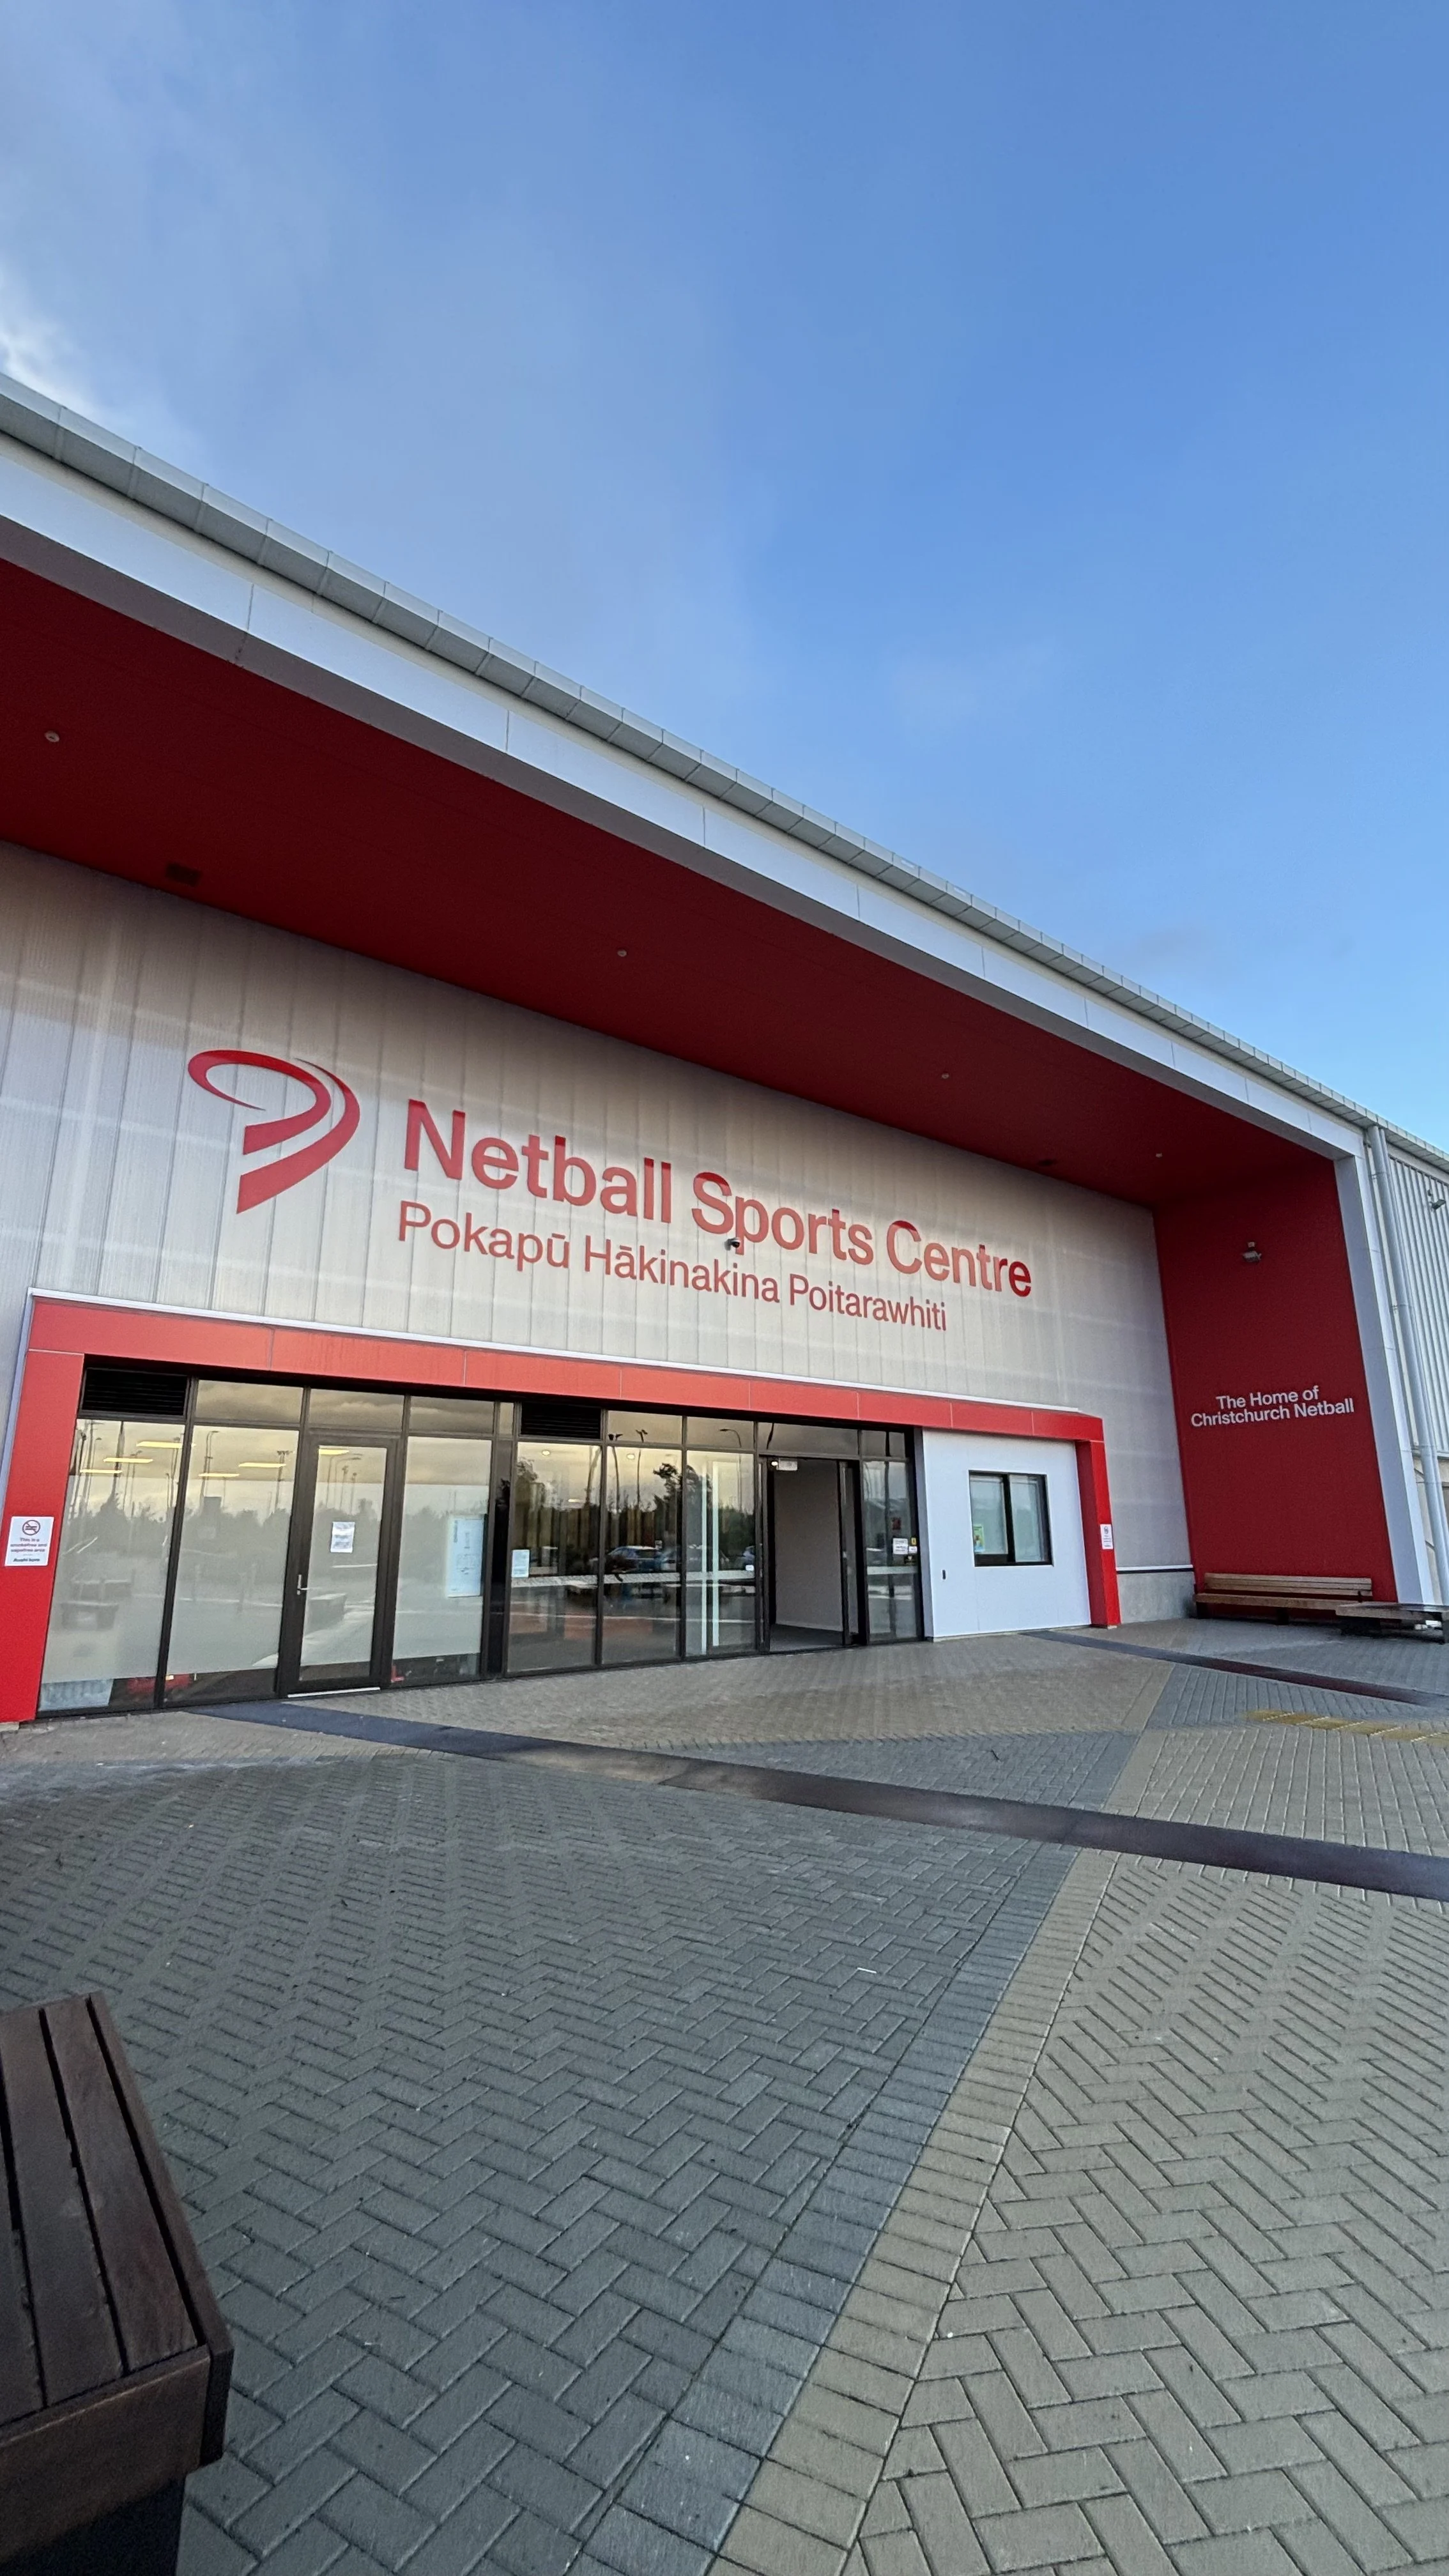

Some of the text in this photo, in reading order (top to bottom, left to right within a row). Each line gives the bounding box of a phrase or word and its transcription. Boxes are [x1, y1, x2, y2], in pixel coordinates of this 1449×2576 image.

[404, 1099, 1031, 1298] Netball Sports Centre
[399, 1200, 946, 1331] Pokapū Hākinakina Poitarawhiti
[1191, 1398, 1354, 1427] Christchurch Netball
[1216, 1385, 1319, 1409] The Home of
